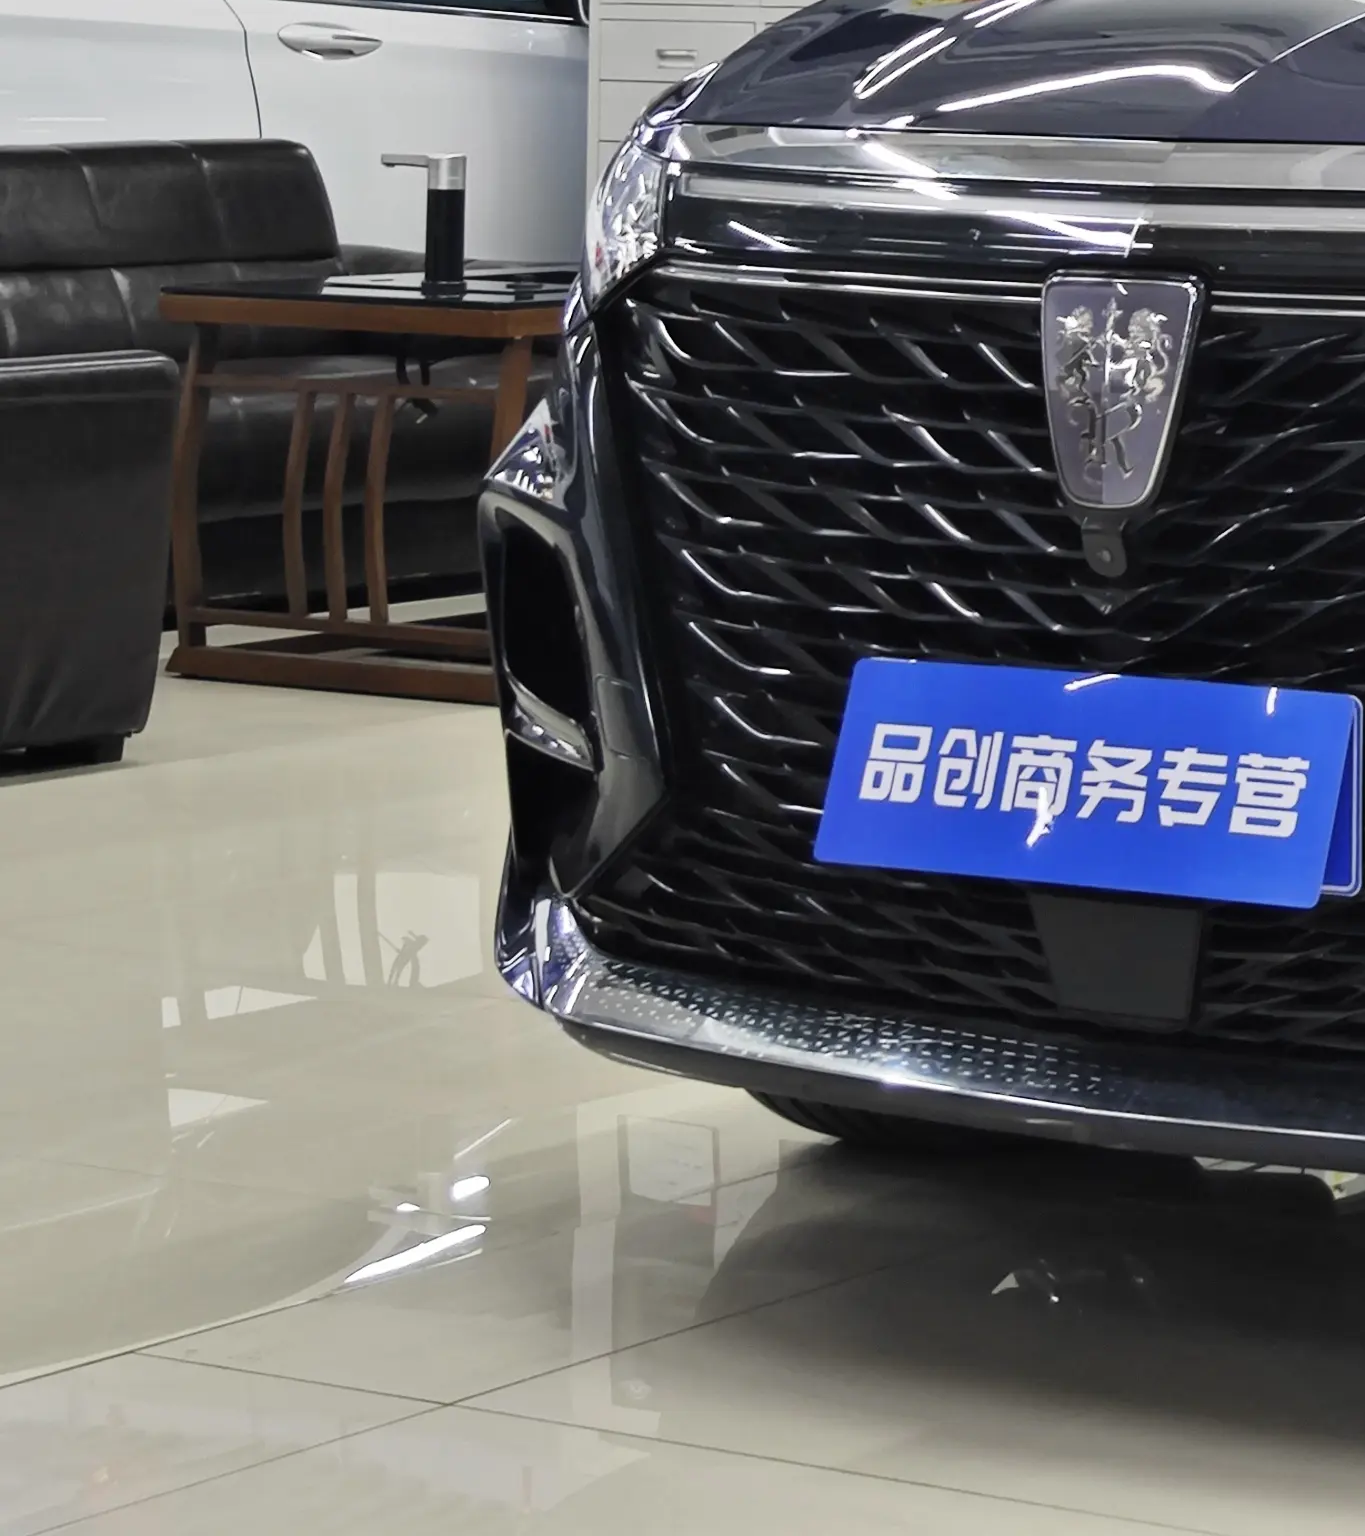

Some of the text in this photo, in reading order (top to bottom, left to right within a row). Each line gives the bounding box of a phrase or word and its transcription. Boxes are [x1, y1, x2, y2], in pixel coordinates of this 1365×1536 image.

[858, 722, 1311, 840] 品创商务专营
